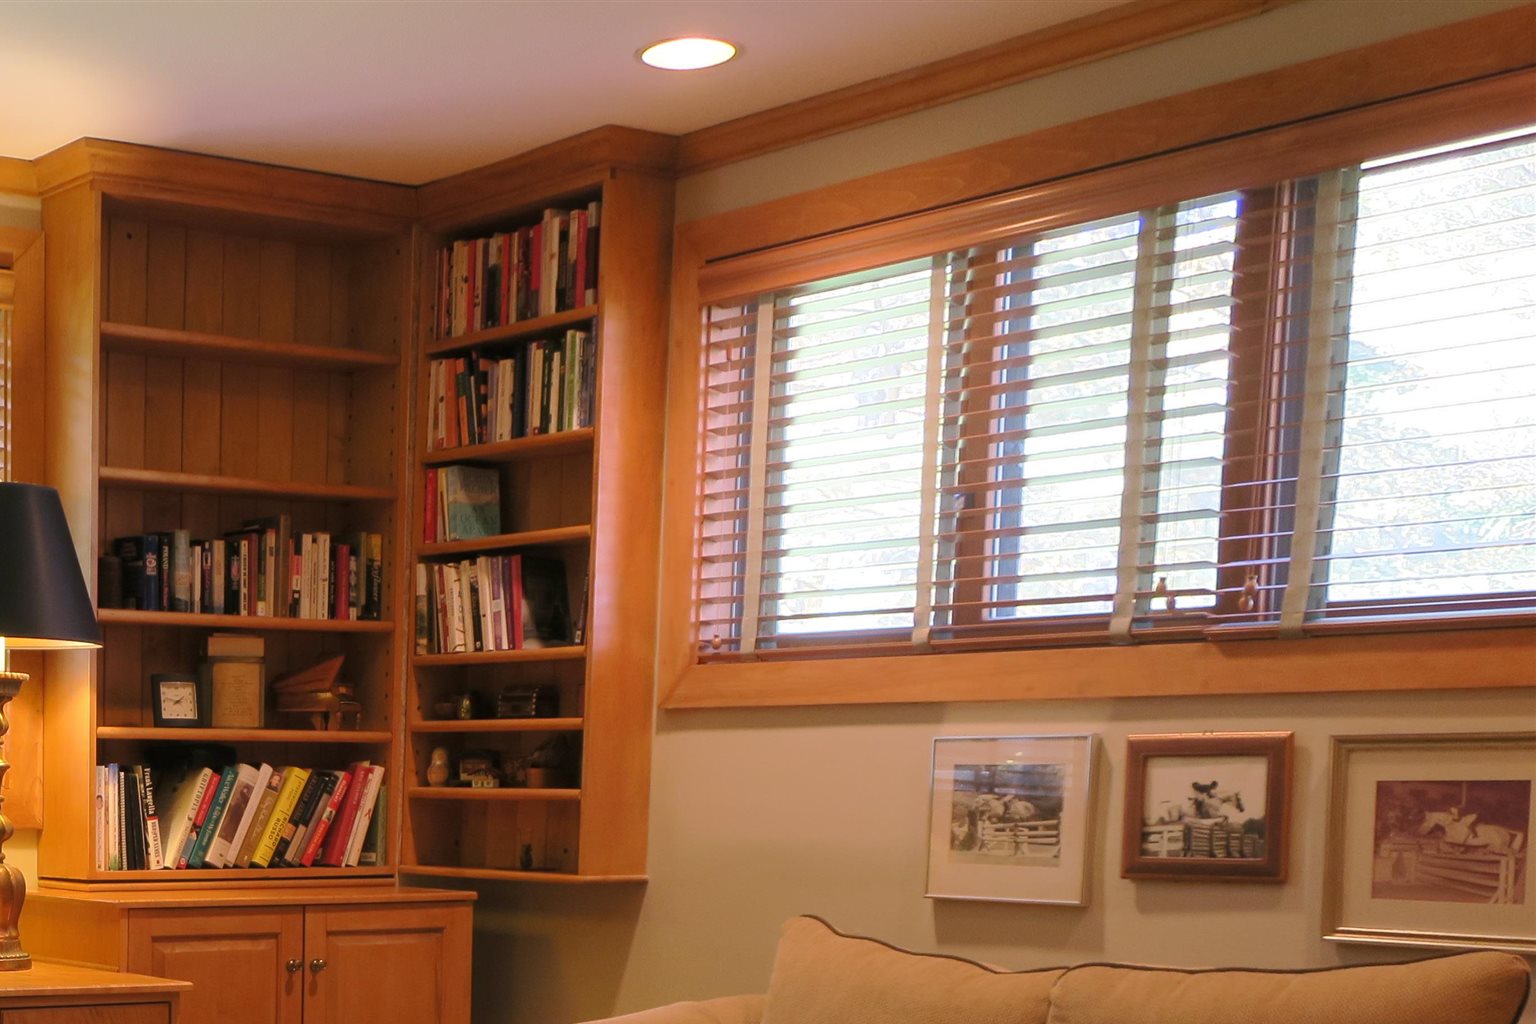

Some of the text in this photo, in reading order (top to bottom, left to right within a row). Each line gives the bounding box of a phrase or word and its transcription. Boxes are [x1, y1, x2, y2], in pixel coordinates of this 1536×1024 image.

[143, 768, 156, 815] Frank Langella
[268, 817, 282, 841] RUSSO
[271, 816, 288, 847] RICHARD
